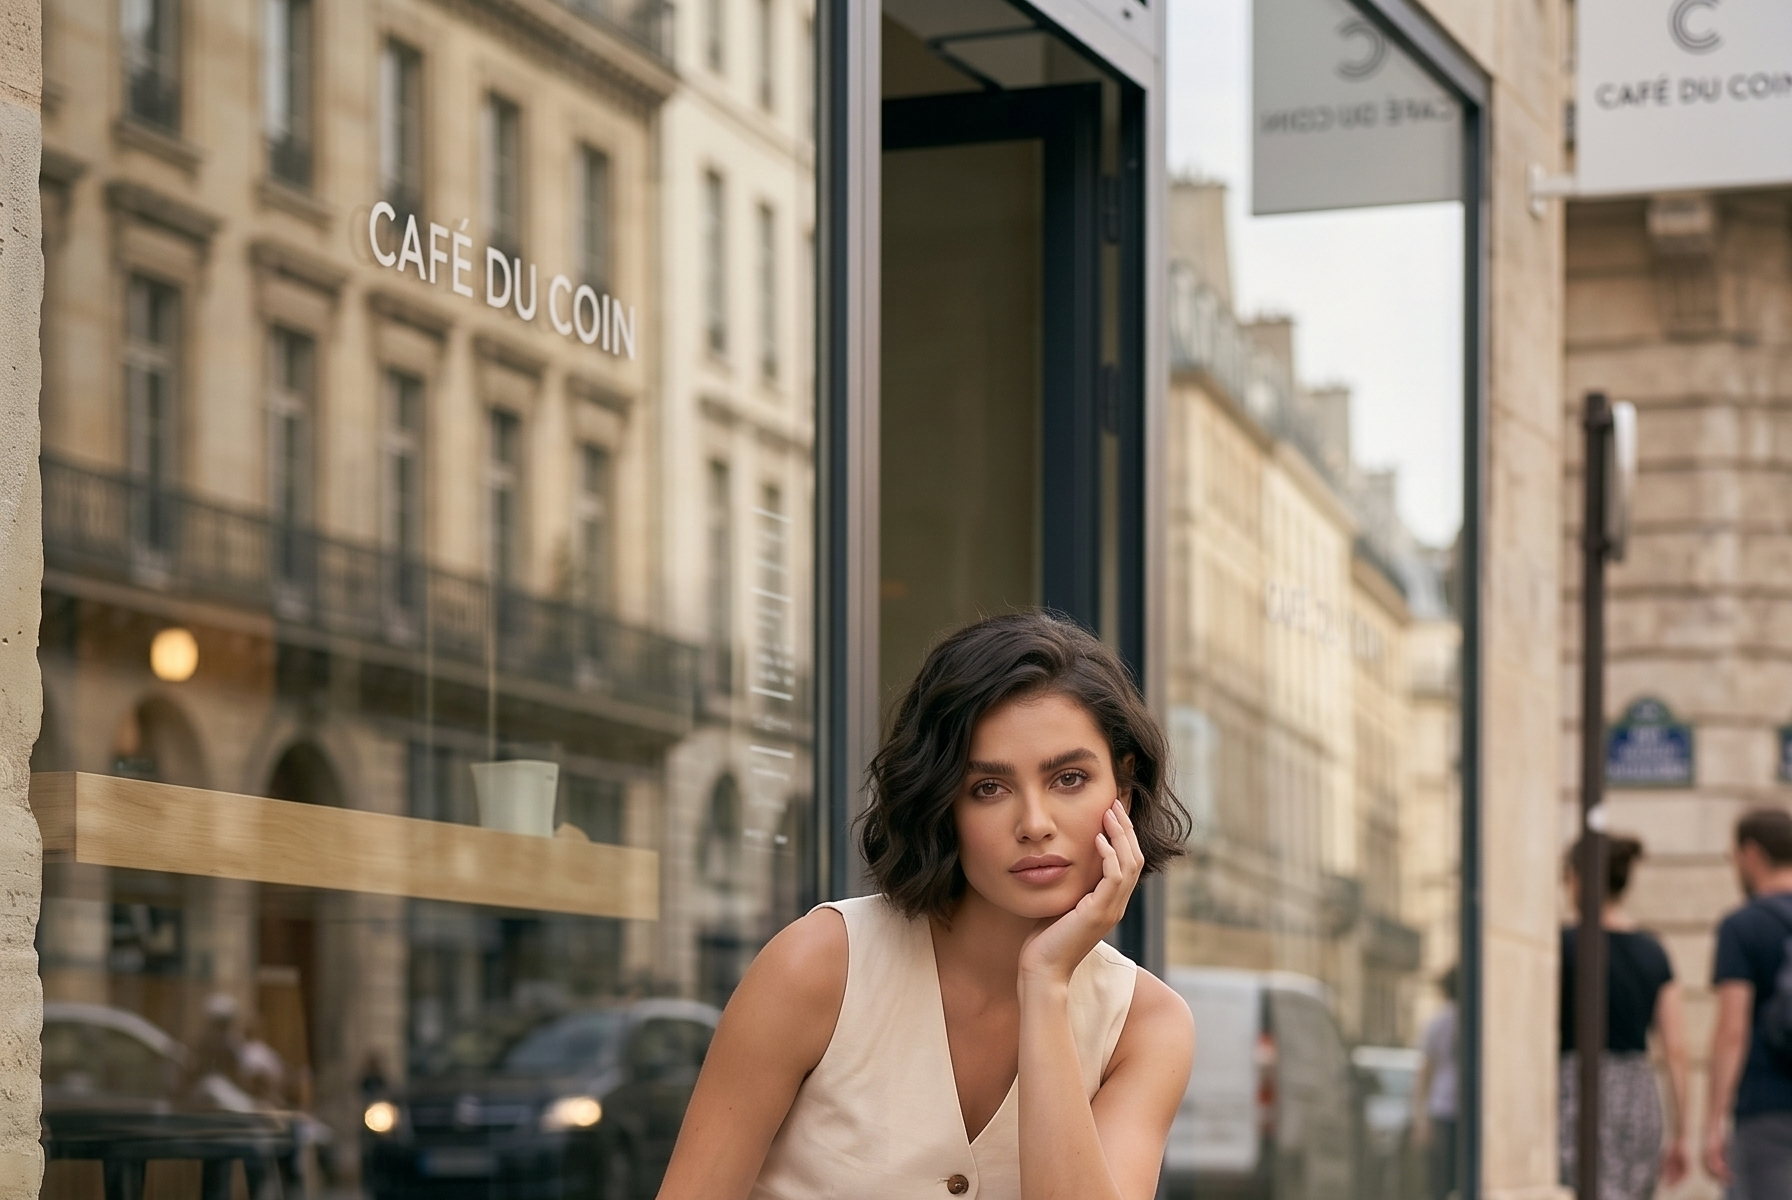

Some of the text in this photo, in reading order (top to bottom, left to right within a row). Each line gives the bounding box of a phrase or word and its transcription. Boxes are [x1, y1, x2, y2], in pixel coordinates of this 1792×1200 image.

[1595, 74, 1670, 110] CAFÉ
[1679, 77, 1722, 104] DU
[369, 201, 635, 360] CAFÉ DU COIN
